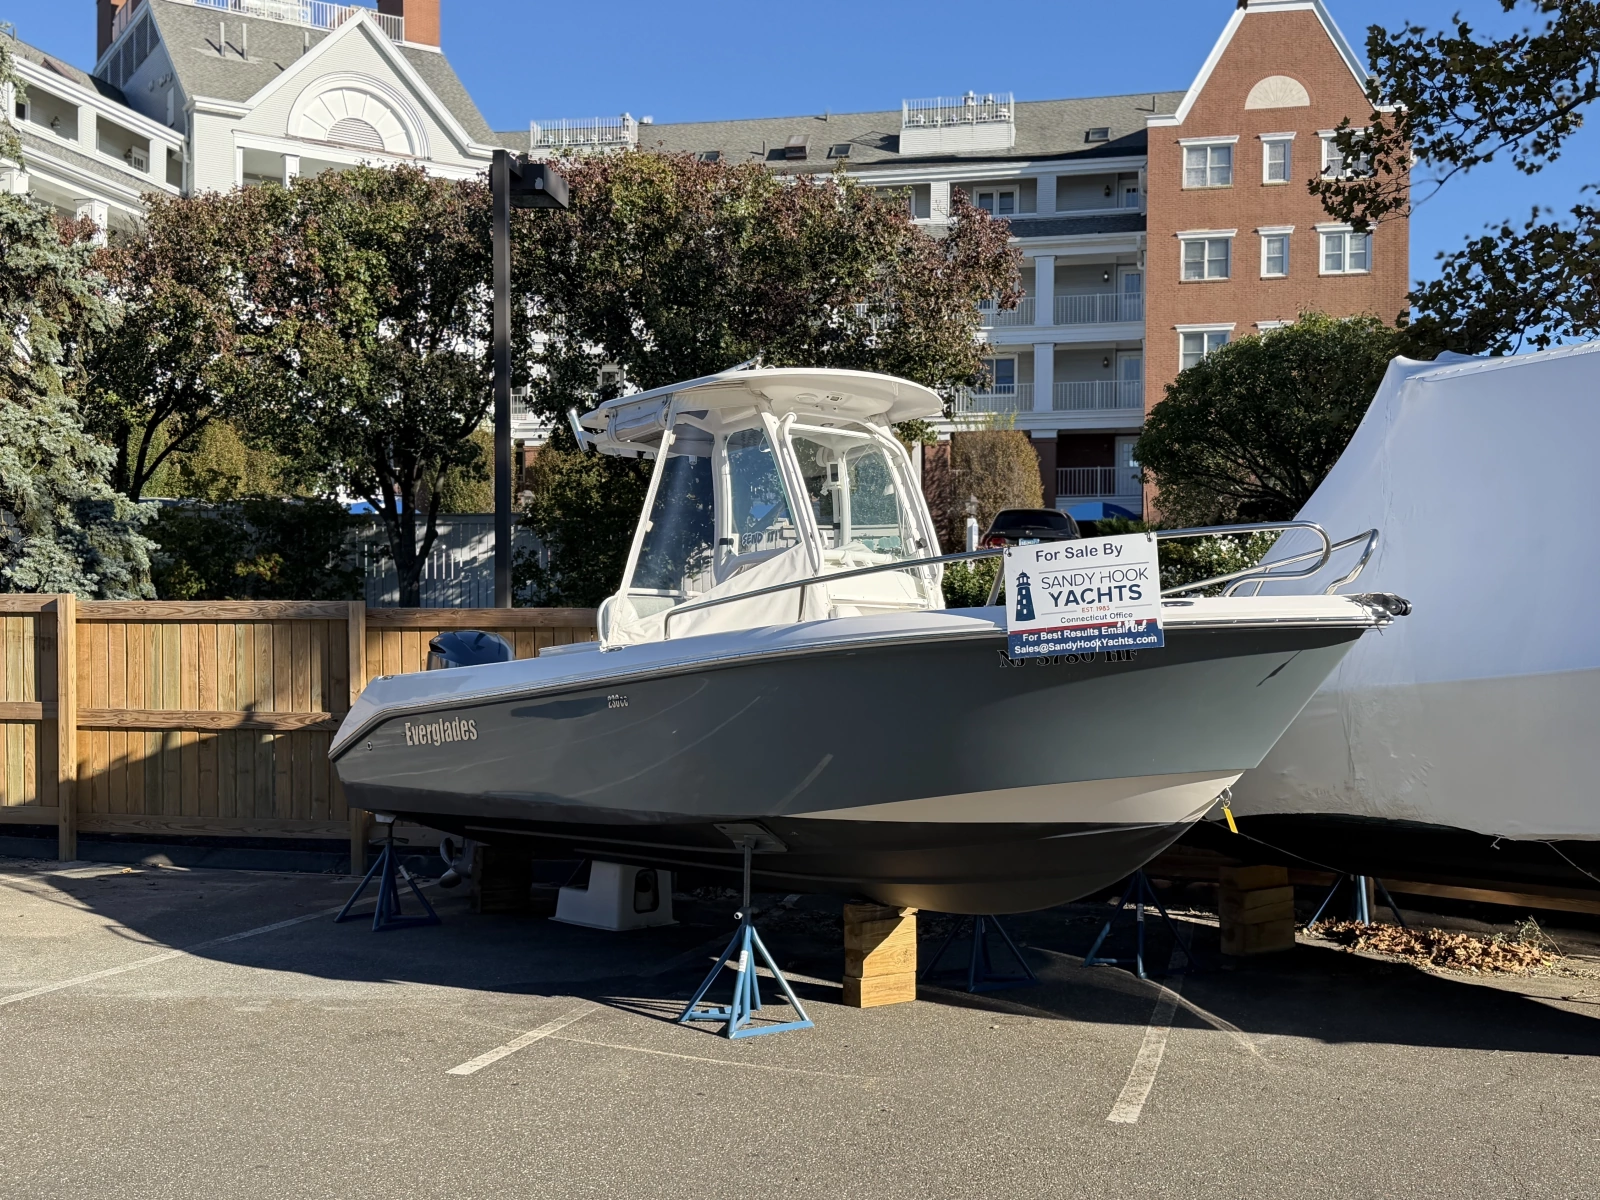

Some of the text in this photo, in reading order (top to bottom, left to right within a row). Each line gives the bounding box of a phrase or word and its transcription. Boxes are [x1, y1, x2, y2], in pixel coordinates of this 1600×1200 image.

[742, 531, 763, 546] SEND
[1036, 543, 1123, 562] For Sale By
[1041, 567, 1149, 590] SANDY HOOK
[1048, 584, 1142, 607] YACHTS
[1060, 612, 1133, 624] Connecticut Office
[1022, 633, 1039, 642] For
[1040, 631, 1062, 640] Best
[1064, 628, 1099, 638] Results
[1102, 624, 1128, 635] Email
[1014, 634, 1158, 654] Sales@SandyHookYachts.com
[404, 717, 478, 746] Everglades
